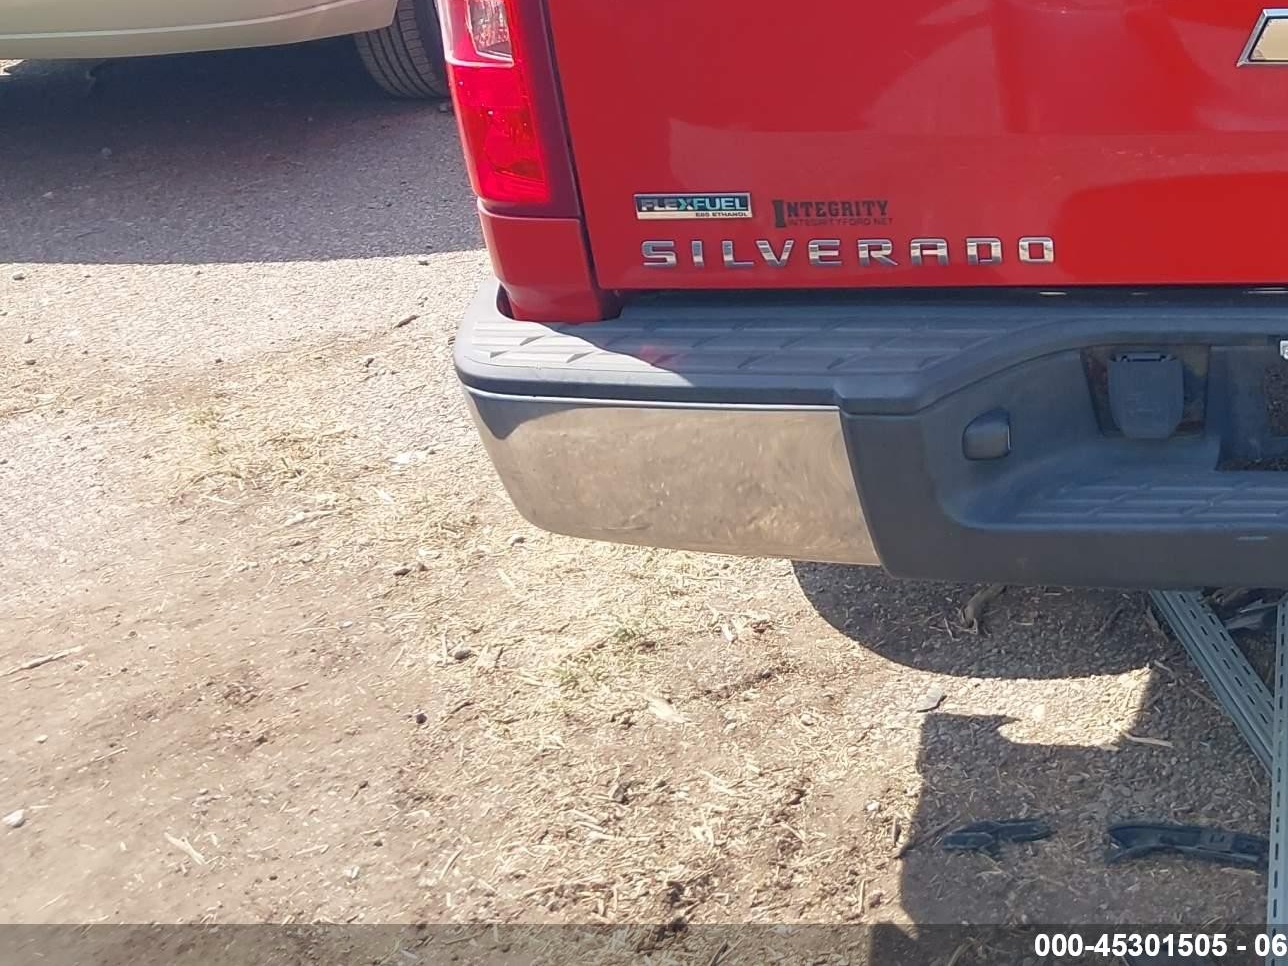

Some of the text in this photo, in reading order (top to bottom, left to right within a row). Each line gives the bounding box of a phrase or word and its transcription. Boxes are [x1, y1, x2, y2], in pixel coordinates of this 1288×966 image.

[640, 197, 749, 211] FLEXFUEL
[772, 199, 889, 228] INTEGRITY
[640, 237, 1056, 268] SILVERADO
